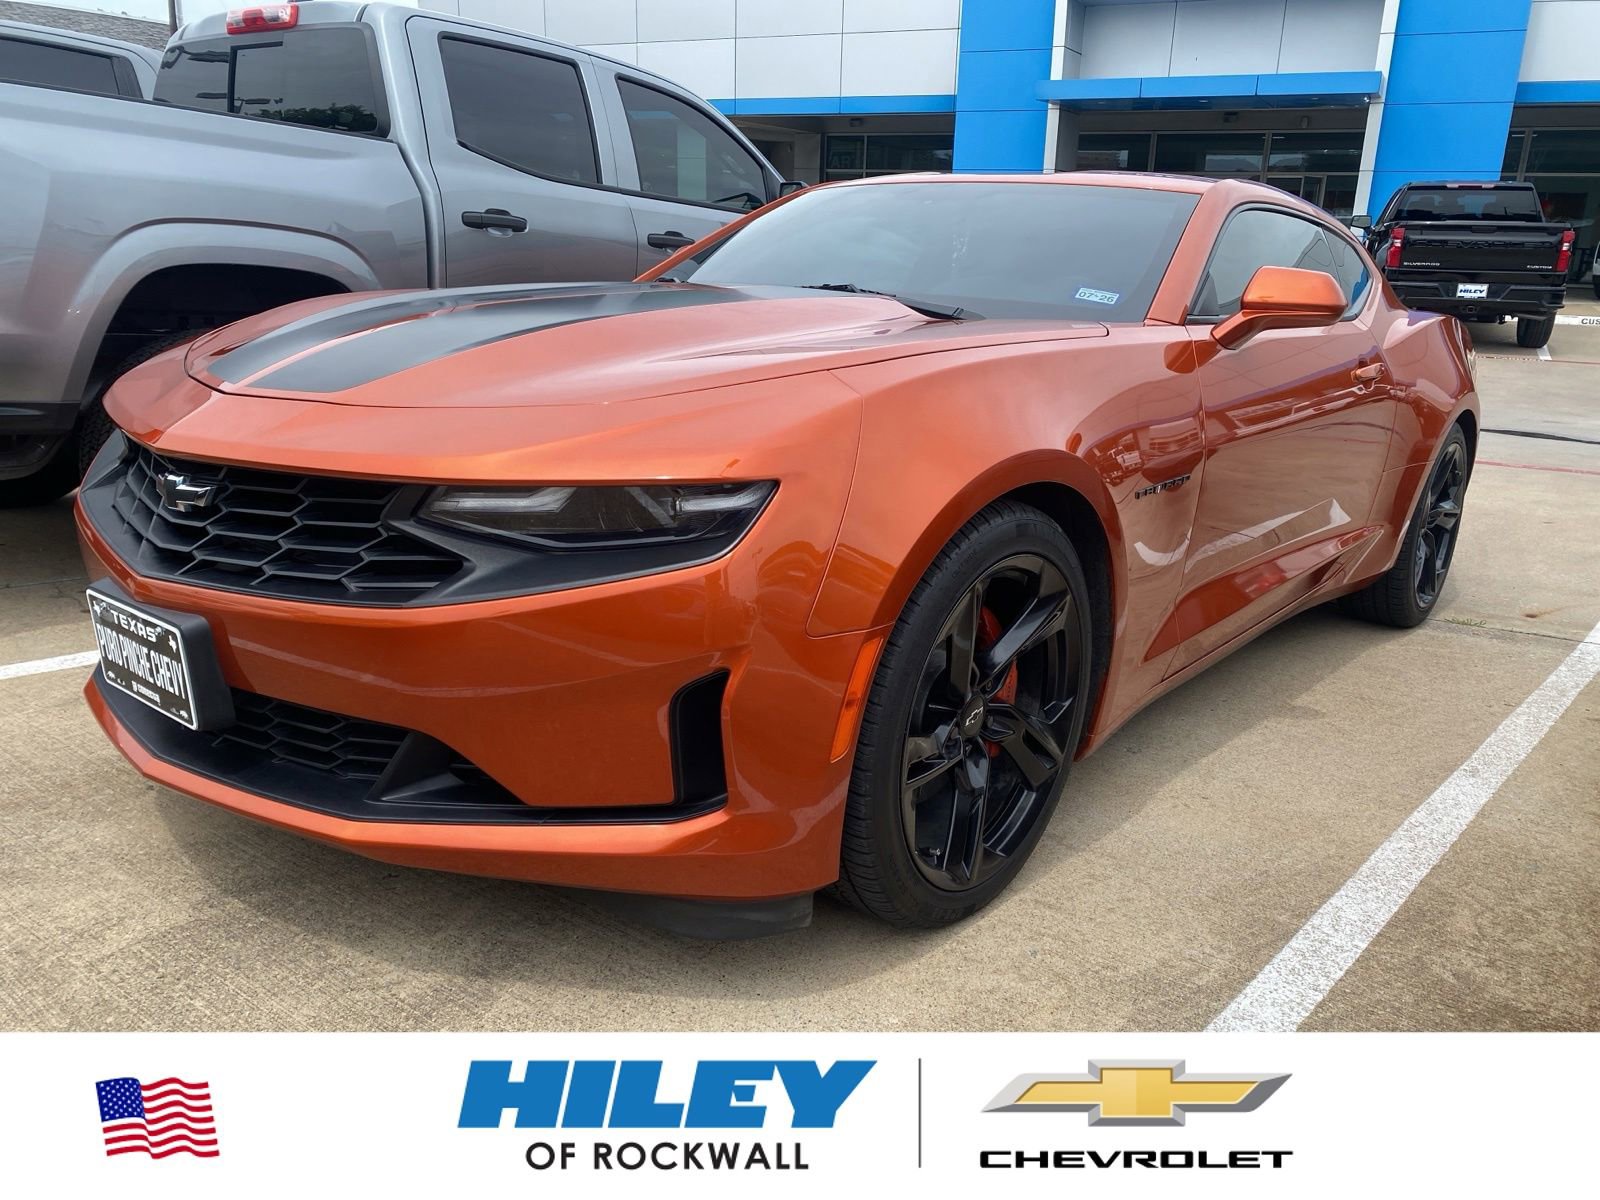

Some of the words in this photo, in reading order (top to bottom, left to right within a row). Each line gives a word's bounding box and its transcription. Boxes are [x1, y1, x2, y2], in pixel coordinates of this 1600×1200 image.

[110, 609, 157, 643] TEXAS
[96, 622, 123, 667] PURO
[118, 633, 154, 684] PINCHE
[150, 649, 185, 700] CHEVY
